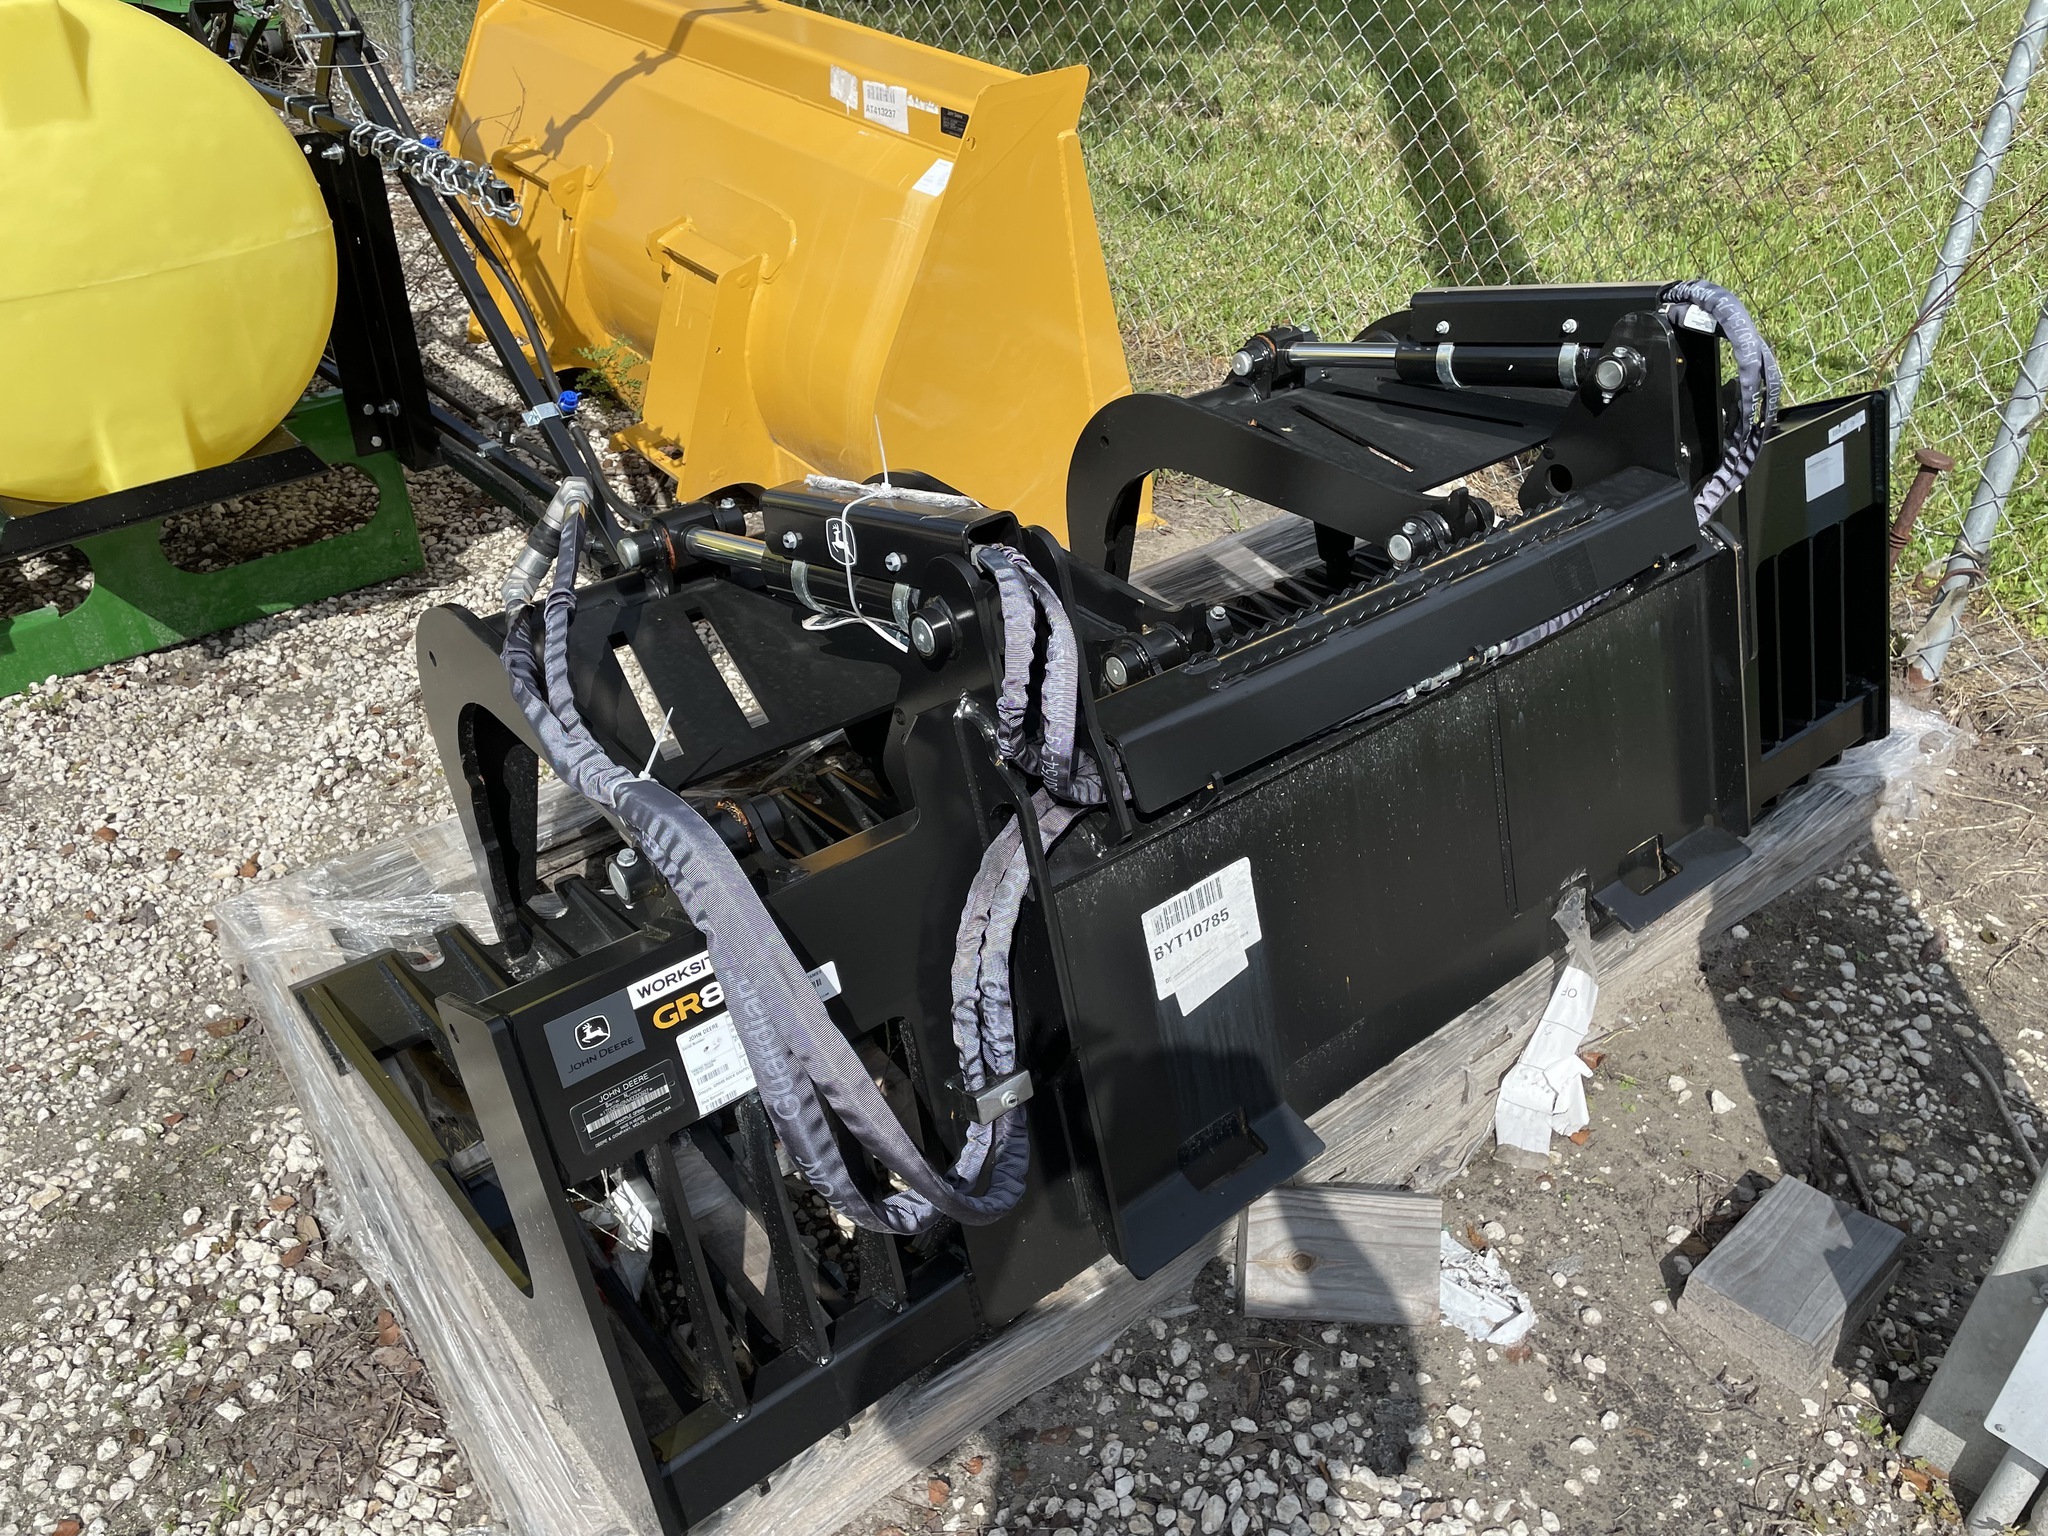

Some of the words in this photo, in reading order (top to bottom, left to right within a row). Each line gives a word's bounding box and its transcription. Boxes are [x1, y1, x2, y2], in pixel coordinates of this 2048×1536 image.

[865, 103, 897, 119] AT413237
[1153, 906, 1230, 962] BYT10785
[652, 981, 725, 1030] GR8
[688, 1031, 702, 1042] JOHN
[703, 1023, 719, 1035] DEERE
[568, 1054, 598, 1074] JOHN
[598, 1036, 635, 1059] DEERE
[598, 1088, 621, 1103] JOHN
[622, 1073, 650, 1090] DEERE
